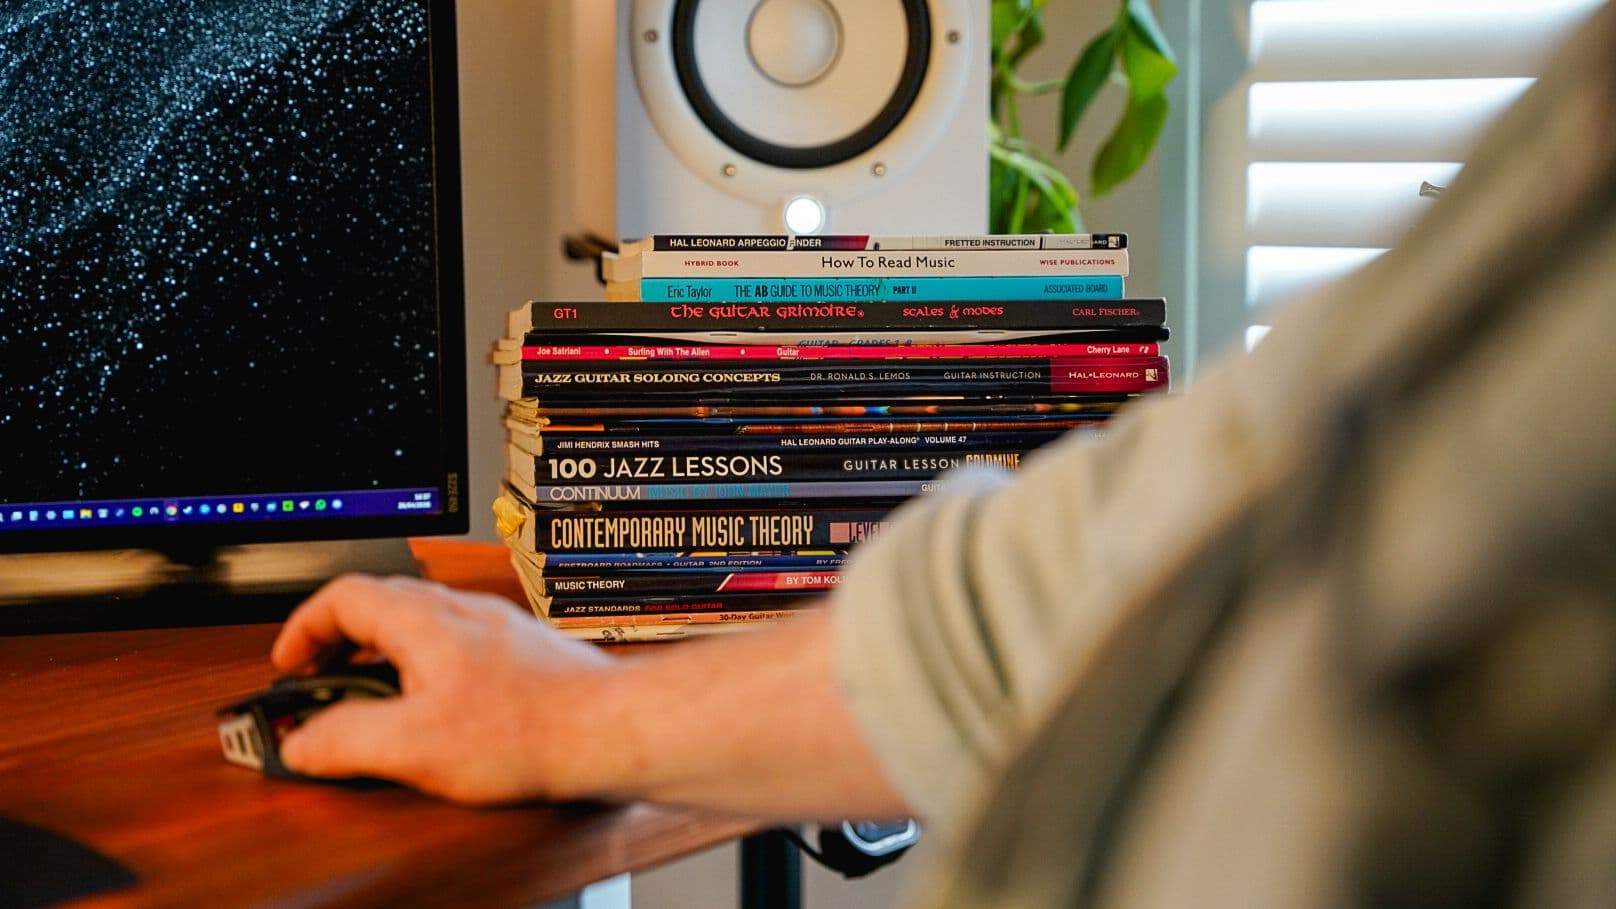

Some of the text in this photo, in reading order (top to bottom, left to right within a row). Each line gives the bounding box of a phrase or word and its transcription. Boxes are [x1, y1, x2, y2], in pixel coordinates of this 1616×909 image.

[669, 238, 688, 247] HAL
[690, 238, 735, 247] LEONARD
[737, 238, 786, 247] ARPEGGIO
[944, 239, 1035, 247] FRETTED INSTRUCTION
[821, 255, 955, 268] How To Read Music
[1060, 258, 1115, 266] PUBLICATIONS
[667, 285, 712, 299] Eric Taylor
[735, 284, 881, 297] THE AB GUIDE TO MUSIC THEORY
[893, 285, 917, 294] PART II
[1043, 284, 1109, 294] ASSOCIATED BOARD
[553, 308, 577, 319] GT1
[949, 305, 959, 318] &
[1072, 308, 1096, 316] CARL
[536, 347, 581, 356] Joe Satriani
[628, 347, 710, 358] Surfing With The Alien
[777, 347, 799, 357] Guitar
[1087, 346, 1130, 355] Cherry Lane
[534, 373, 781, 384] JAZZ GUITAR SOLOING CONCEPTS
[810, 373, 911, 381] DR. RONALD S. LEMOS
[943, 371, 1041, 380] GUITAR INSTRUCTION
[557, 440, 660, 449] JIMI HENDRIX SMASH HITS
[781, 438, 798, 446] HAL
[798, 438, 837, 446] LEONARD
[958, 436, 967, 444] 47
[549, 455, 783, 479] 100 JAZZ LESSONS
[843, 460, 897, 471] GUITAR
[904, 459, 960, 470] LESSON
[550, 485, 641, 501] CONTINUUM
[648, 483, 790, 498] MUSIC BY JOHN MAYER
[551, 515, 813, 548] CONTEMPORARY MUSIC THEORY
[555, 580, 625, 591] MUSIC THEORY
[786, 577, 799, 585] BY
[802, 576, 821, 584] TOM
[719, 614, 746, 622] 30-Day
